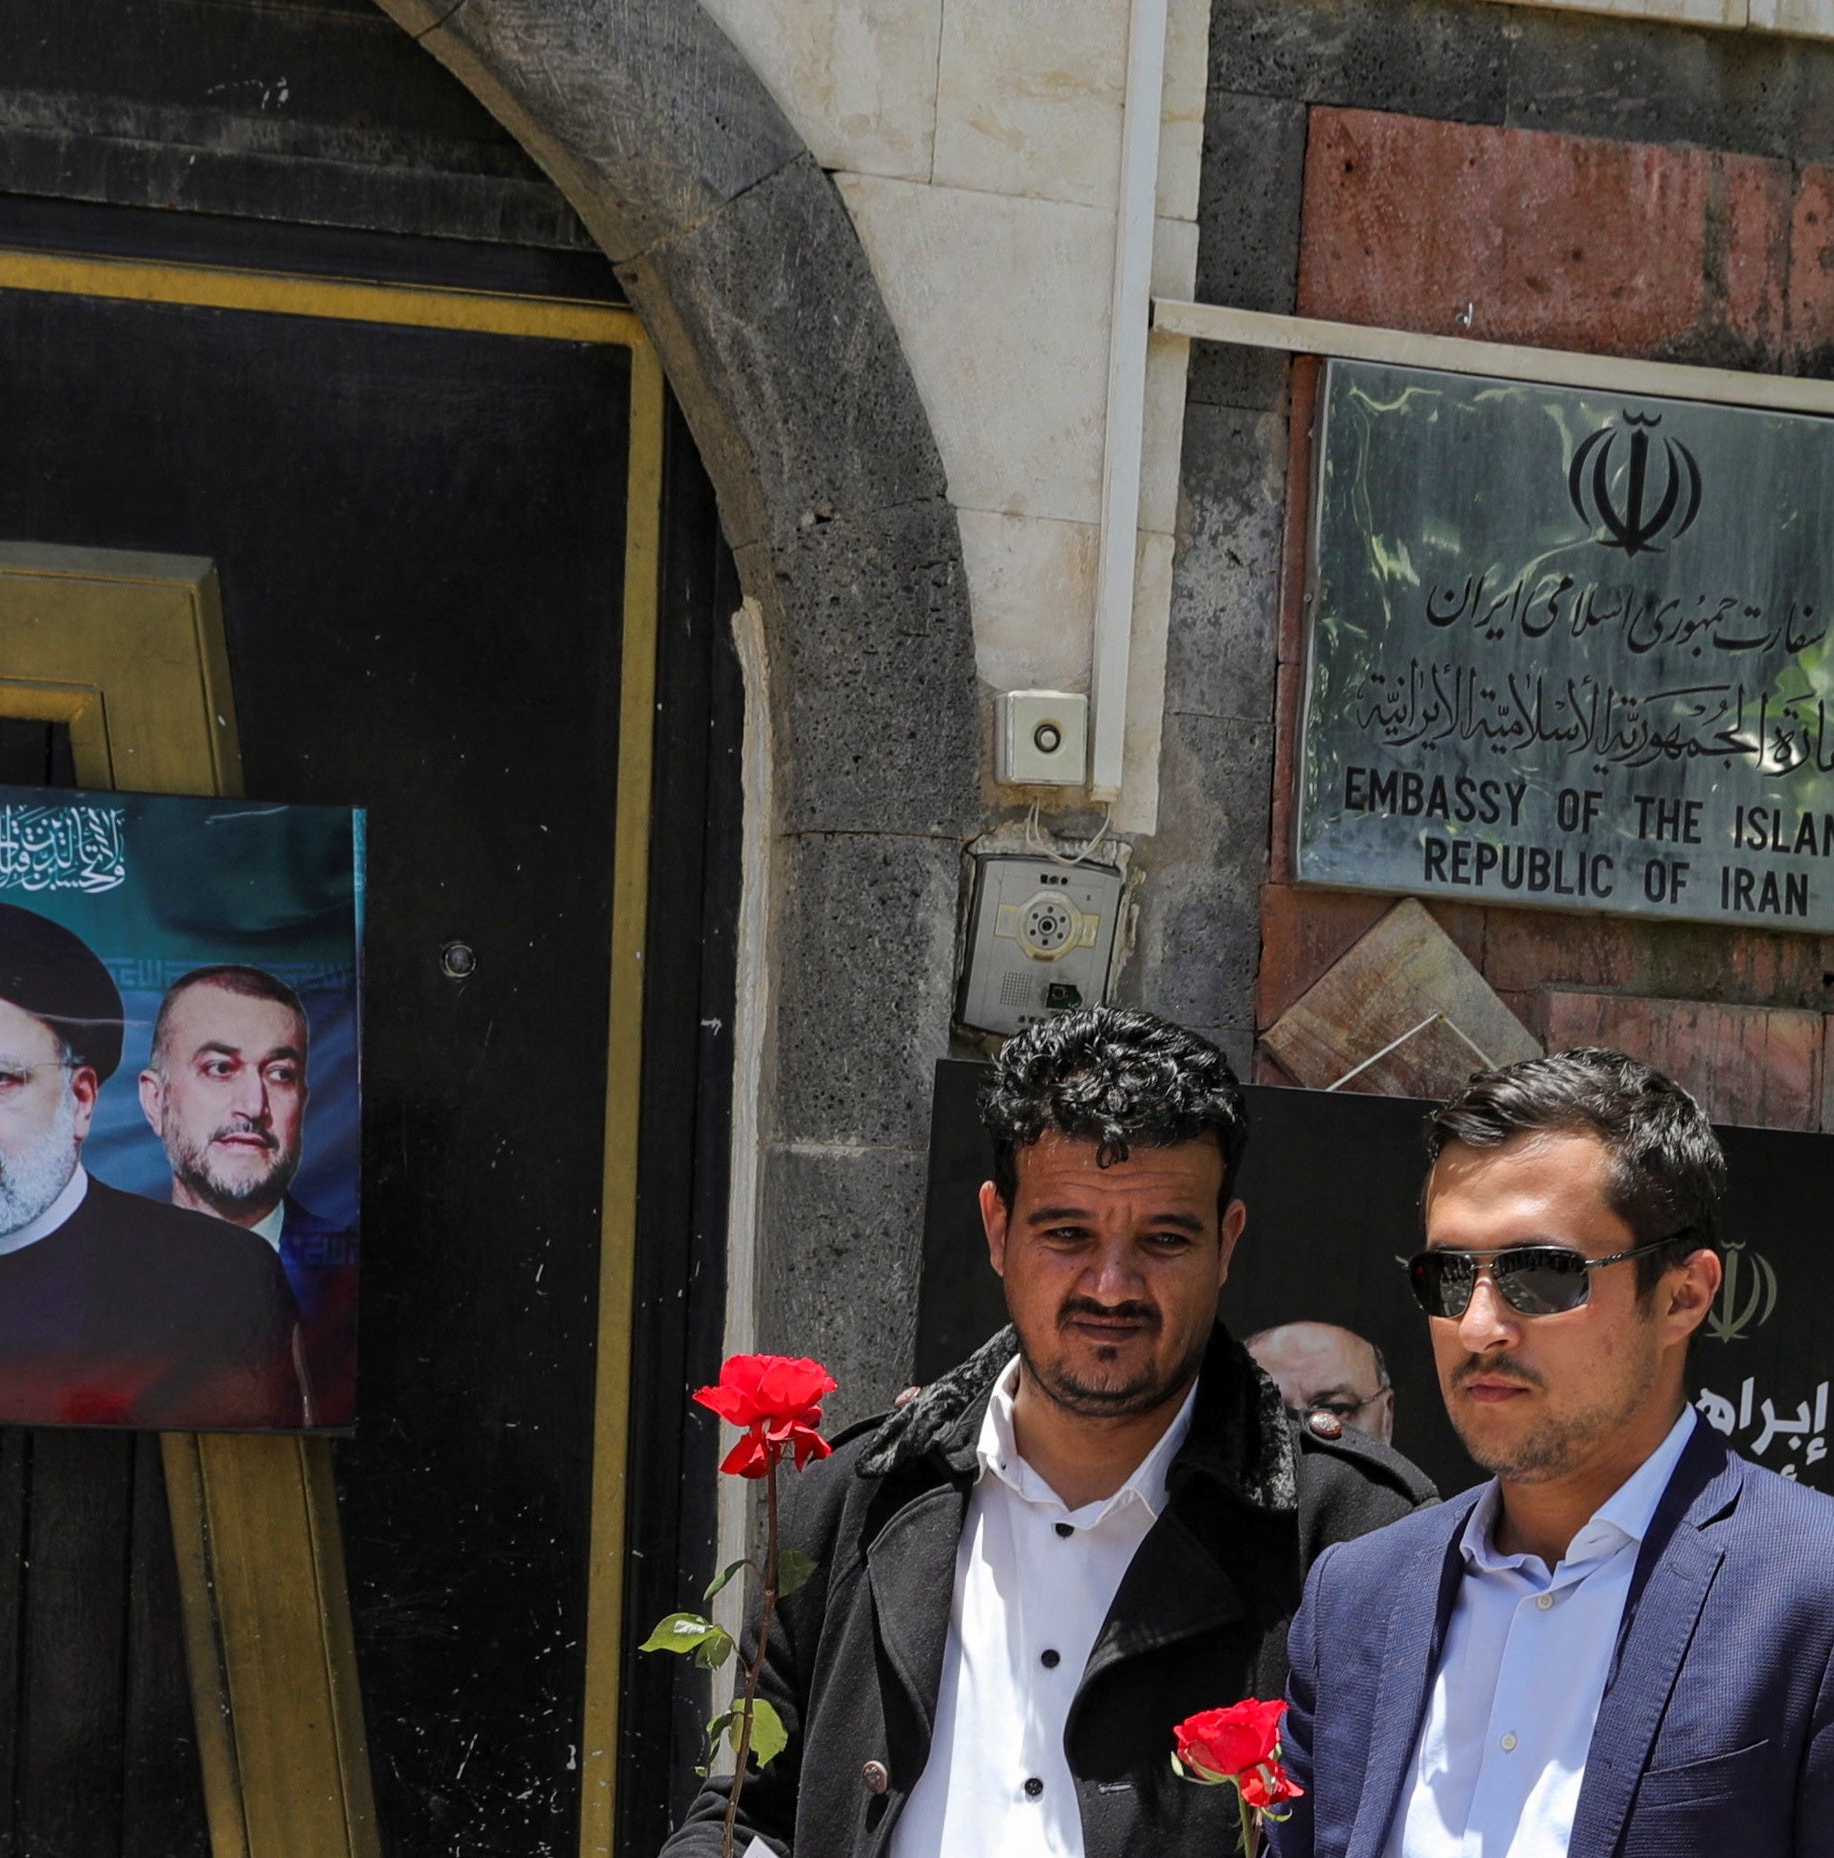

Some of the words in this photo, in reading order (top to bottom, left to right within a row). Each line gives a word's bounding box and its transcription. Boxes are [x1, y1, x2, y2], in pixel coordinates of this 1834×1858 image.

[1713, 602, 1826, 655] سفارت
[1344, 766, 1527, 827] EMBASSY
[1556, 787, 1603, 834] OF
[1633, 795, 1704, 844] THE
[1423, 836, 1614, 899] REPUBLIC
[1644, 860, 1690, 904] OF
[1721, 865, 1809, 918] IRAN
[1694, 1377, 1829, 1466] إبراه
